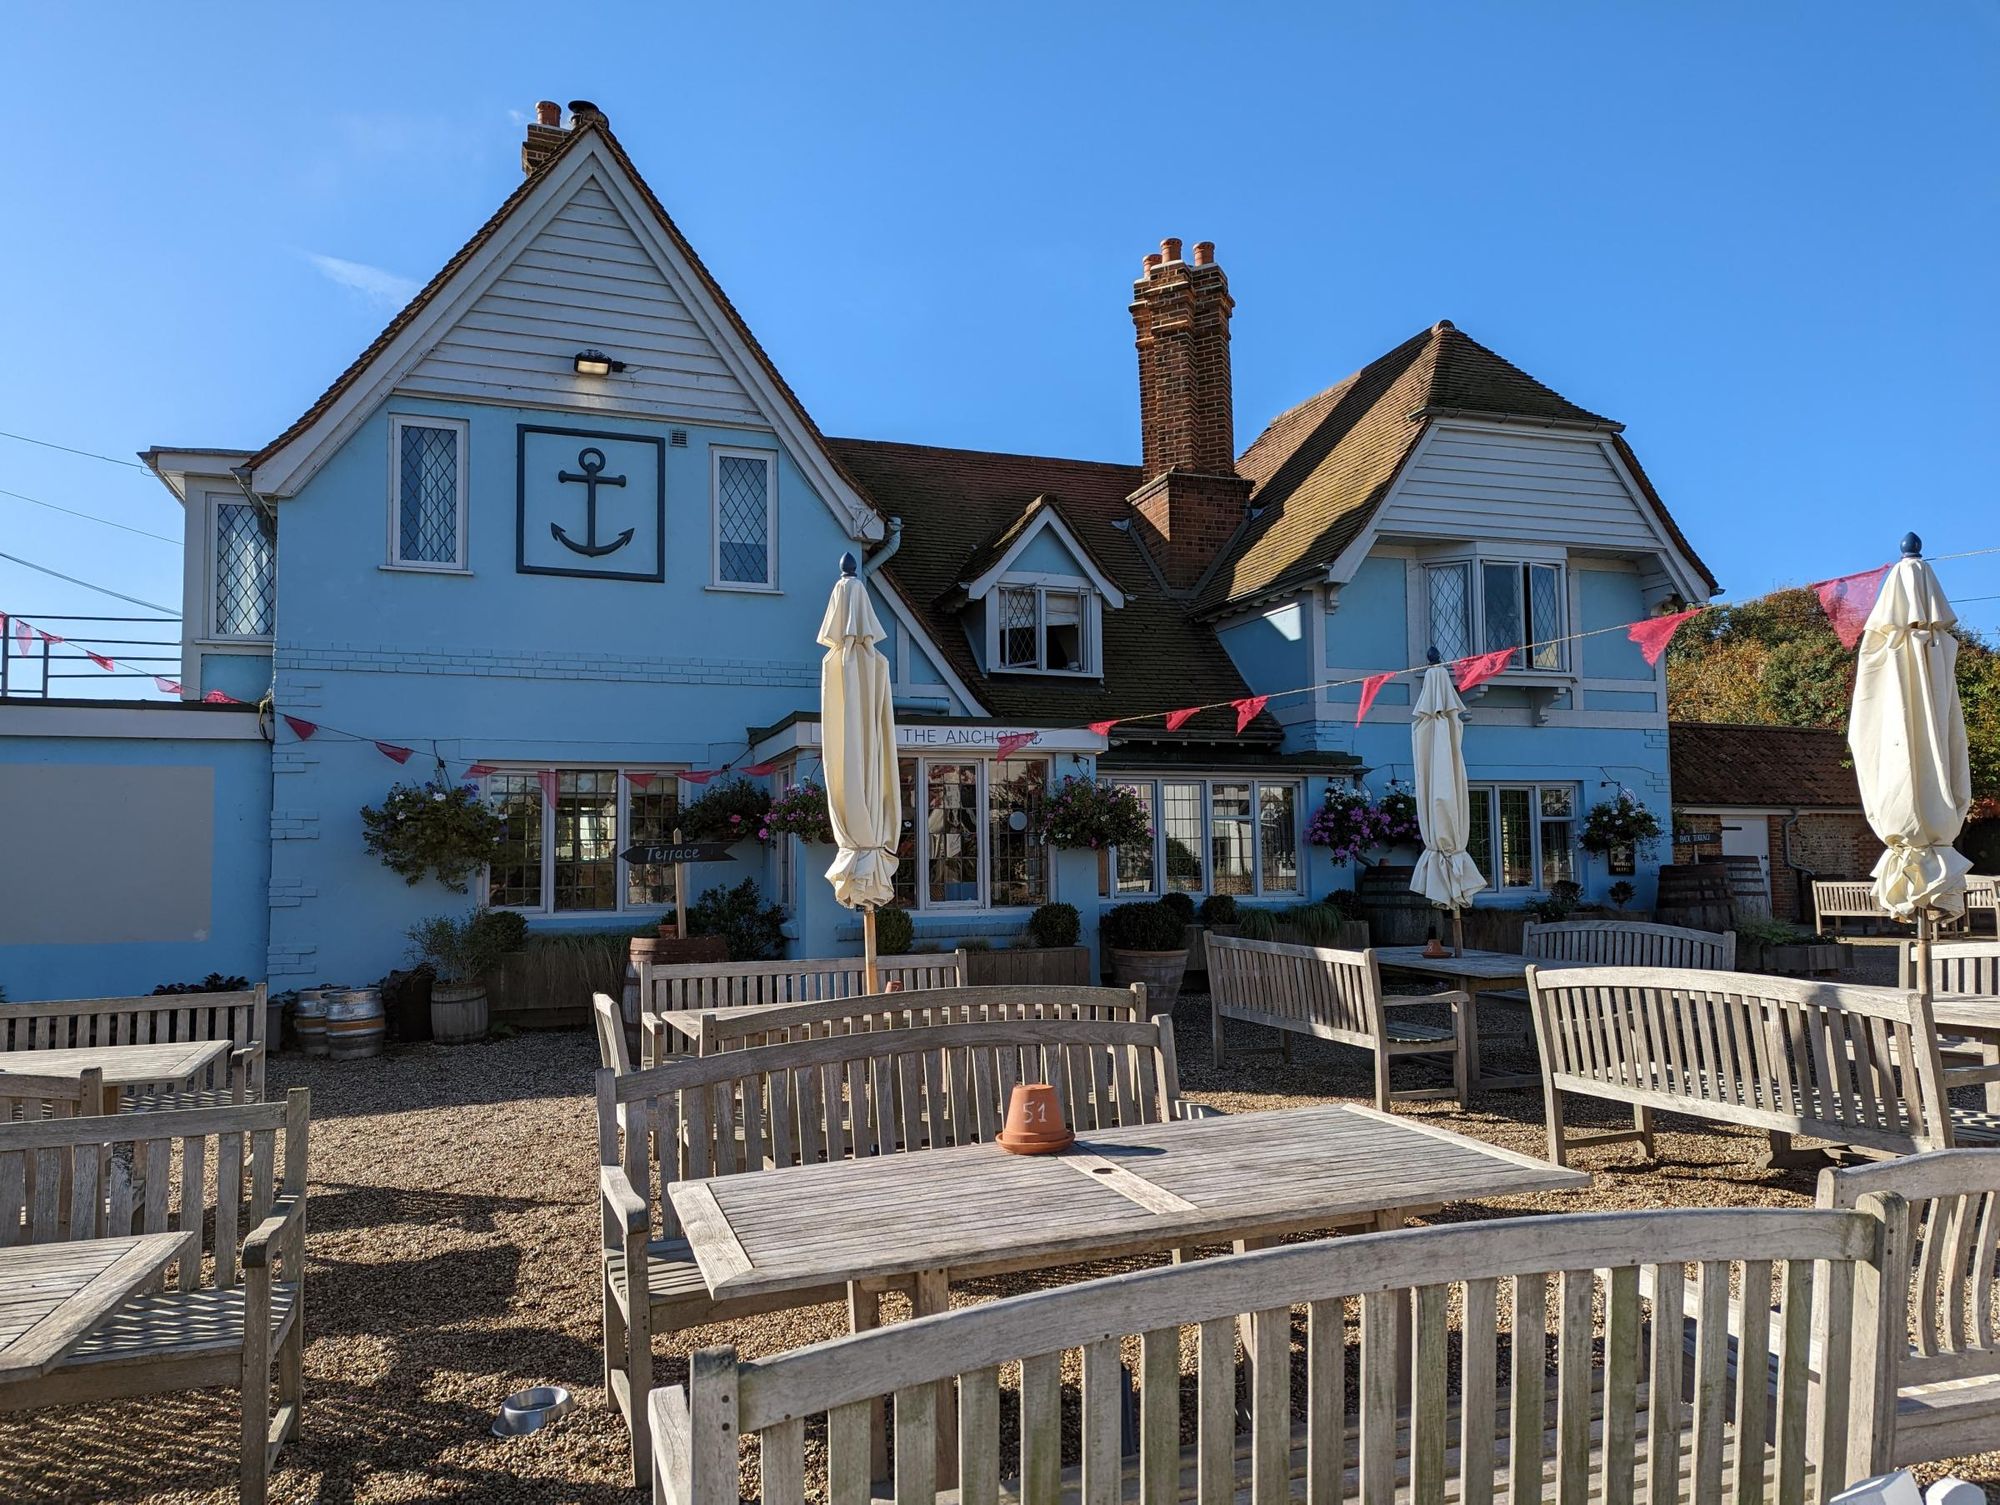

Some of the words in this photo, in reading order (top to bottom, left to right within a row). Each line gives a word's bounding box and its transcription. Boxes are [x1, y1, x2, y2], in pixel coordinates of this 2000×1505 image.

[904, 729, 937, 743] THE
[946, 730, 1020, 744] ANCHOR
[645, 847, 700, 861] Terrace
[1022, 1100, 1048, 1123] 51
